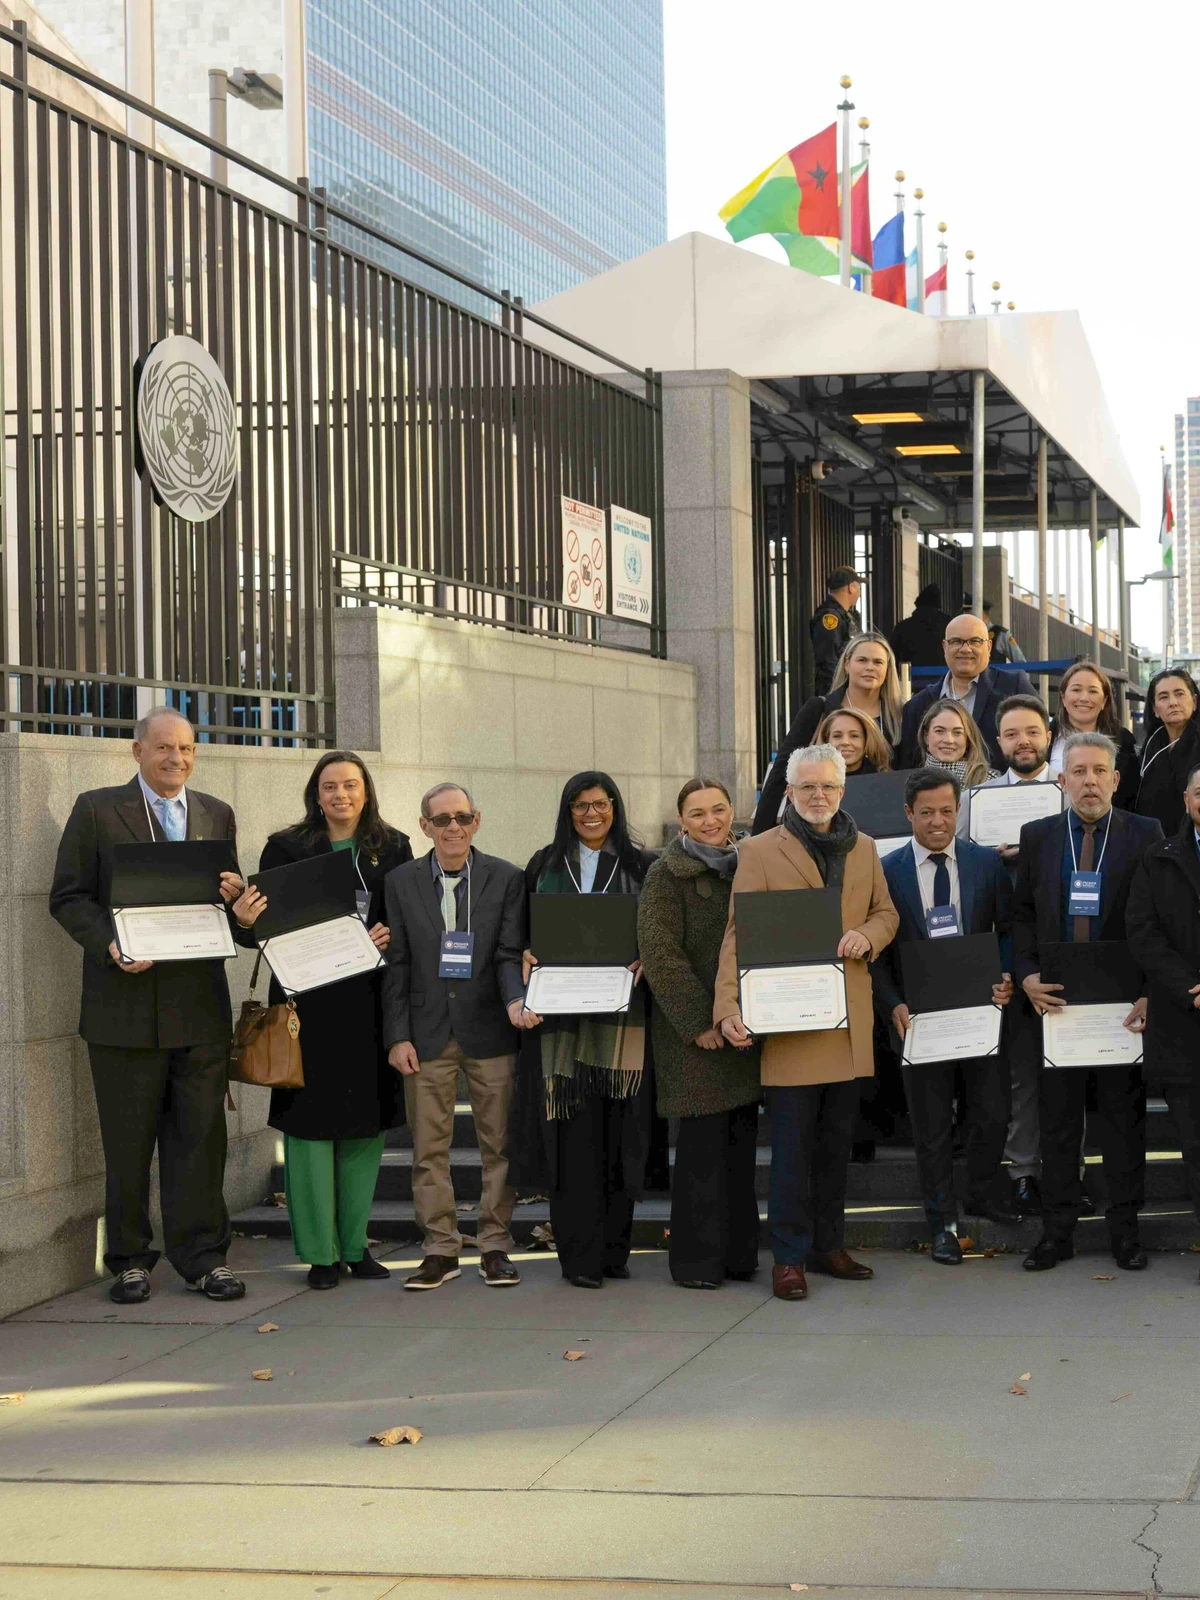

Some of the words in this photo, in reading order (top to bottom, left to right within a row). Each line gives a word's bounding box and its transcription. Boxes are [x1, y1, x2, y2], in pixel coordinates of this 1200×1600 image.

[616, 515, 634, 527] WELCOME
[614, 522, 630, 535] UNITED
[631, 528, 650, 542] NATIONS
[618, 592, 636, 603] VISITORS
[616, 600, 638, 612] ENTRANCE
